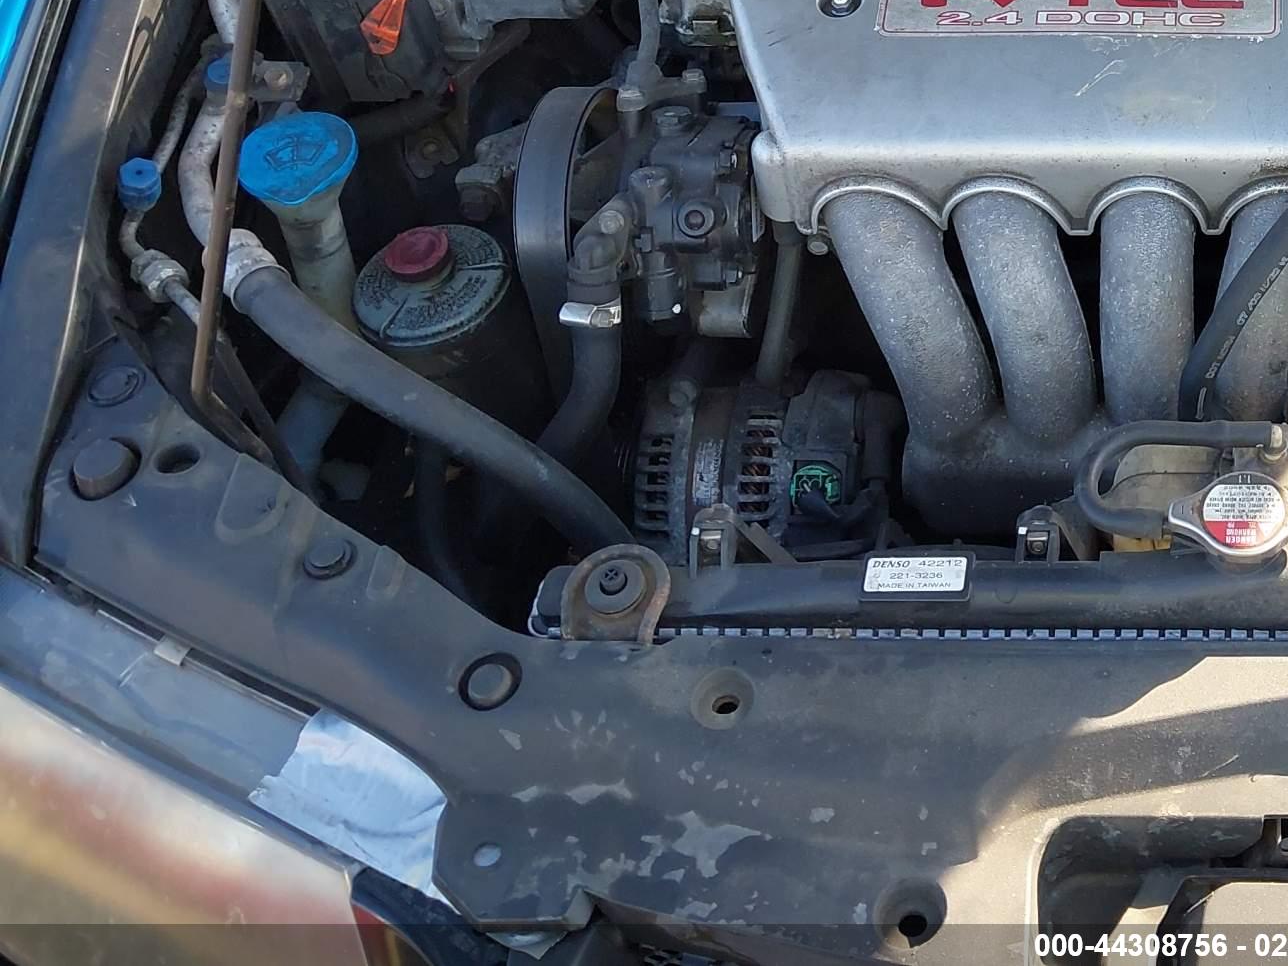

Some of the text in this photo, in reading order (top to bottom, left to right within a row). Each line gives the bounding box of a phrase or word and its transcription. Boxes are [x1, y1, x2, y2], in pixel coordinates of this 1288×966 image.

[935, 9, 1226, 27] 2.4 DOHC
[872, 559, 963, 569] DENSO 42212
[889, 572, 943, 580] 221-3236
